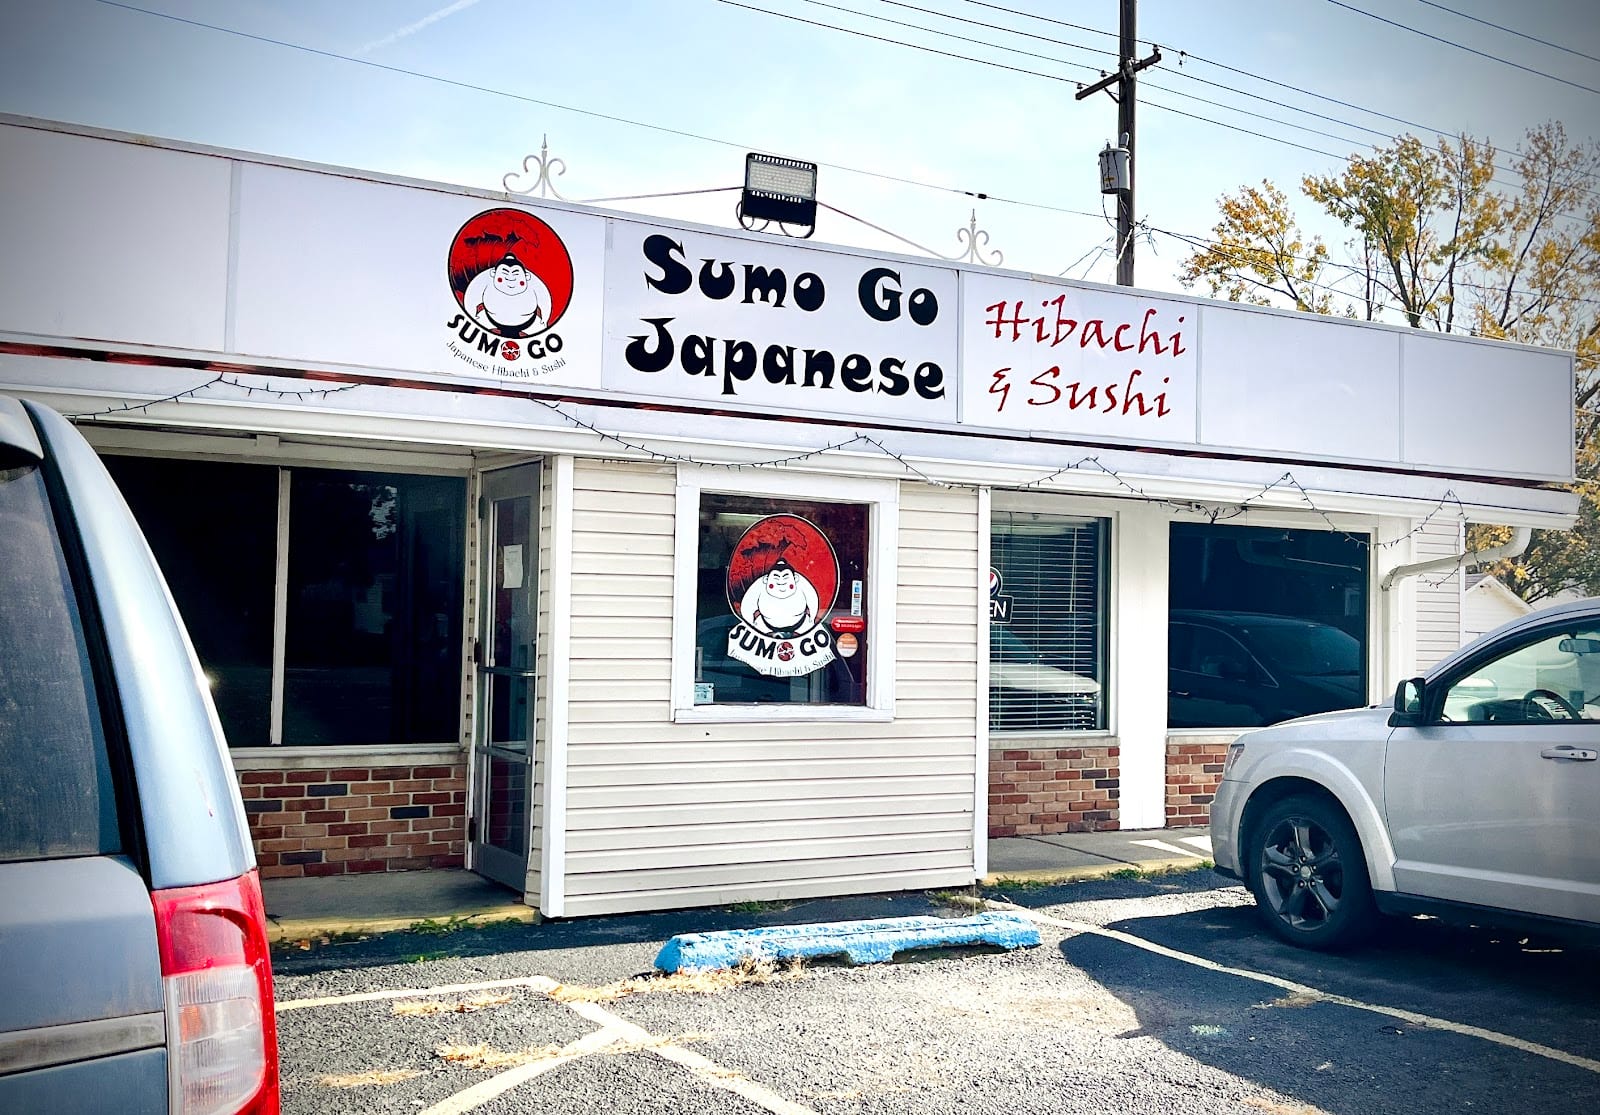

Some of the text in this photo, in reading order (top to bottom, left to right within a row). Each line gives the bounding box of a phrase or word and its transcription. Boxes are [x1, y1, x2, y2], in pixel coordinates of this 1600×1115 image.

[643, 234, 938, 326] Sumo Go
[527, 333, 563, 359] GO
[986, 294, 1186, 357] Hibachi
[446, 340, 489, 372] Japanese
[492, 364, 530, 378] Hibachi
[541, 357, 567, 374] Sushi
[625, 317, 945, 400] Japanese
[988, 365, 1171, 418] & Sushi
[799, 629, 830, 657] GO
